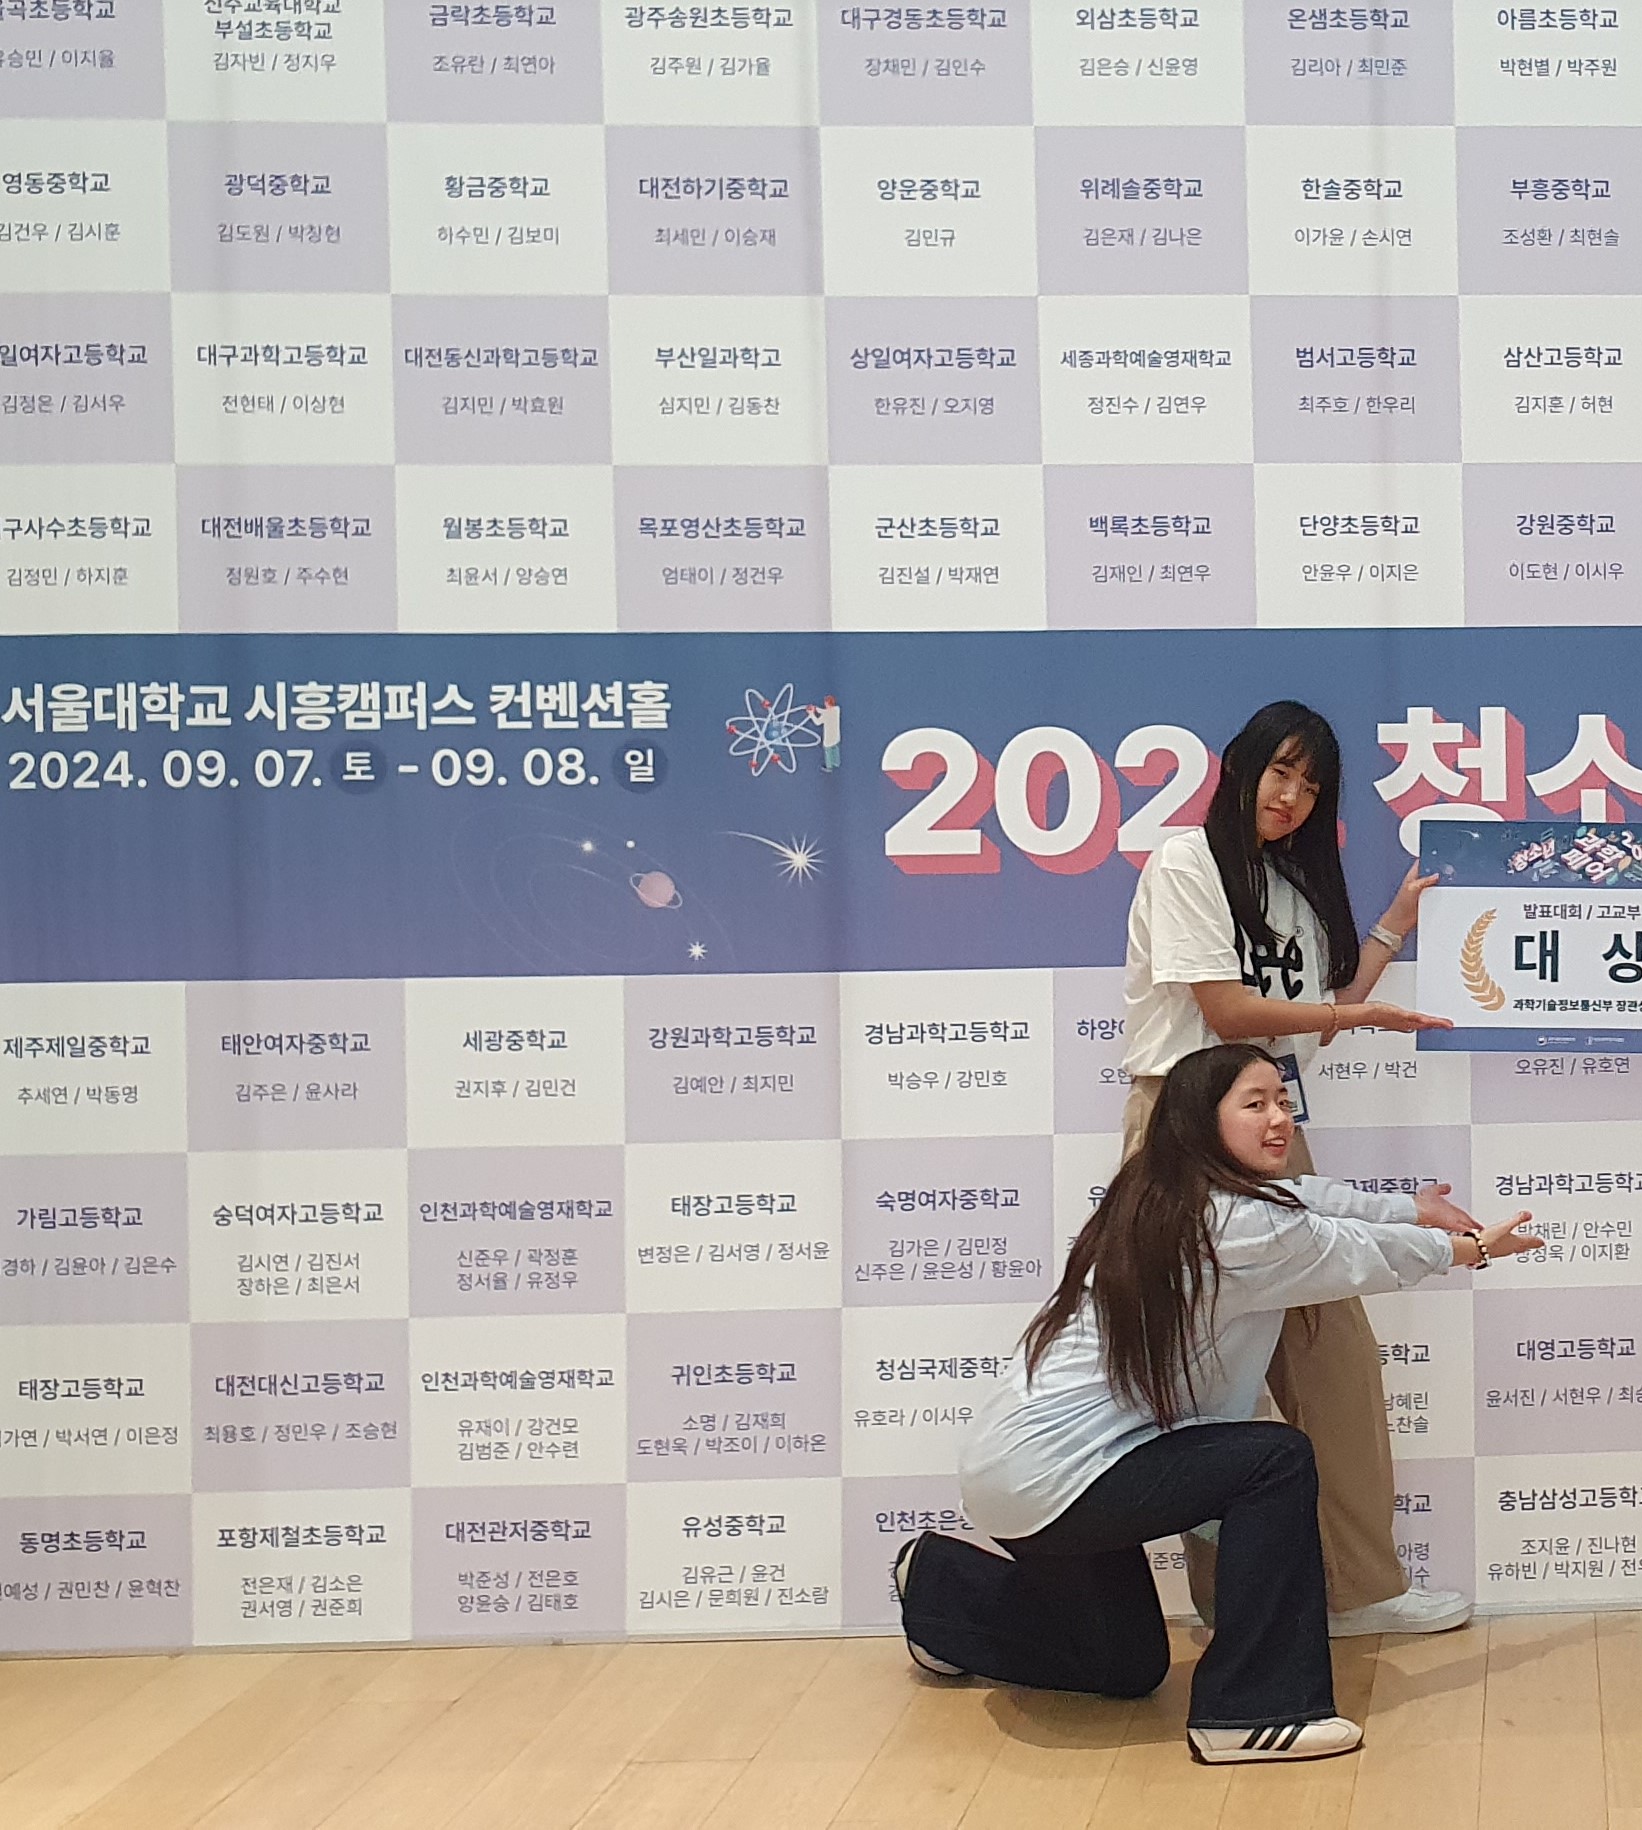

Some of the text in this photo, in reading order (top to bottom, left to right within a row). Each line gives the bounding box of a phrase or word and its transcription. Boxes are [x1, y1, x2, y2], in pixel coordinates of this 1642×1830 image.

[624, 5, 794, 30] 광주송원초등학교
[1075, 7, 1200, 31] 외삼초등학교
[1287, 7, 1411, 31] 온샘초등학교
[1496, 7, 1620, 31] 아름초등학교
[1499, 57, 1617, 78] 박현별 / 박주원
[1, 170, 112, 195] 영동중학교
[444, 174, 551, 200] 황금중학교
[638, 175, 790, 201] 대전하기중학교
[876, 178, 982, 202] 양운중학교
[1079, 177, 1204, 201] 위례솔중학교
[1300, 177, 1404, 201] 한솔중학교
[1509, 177, 1612, 201] 부흥중학교
[904, 228, 956, 248] 김민규
[1294, 227, 1412, 248] 이가윤 / 손시연
[196, 343, 369, 369] 대구과학고등학교
[654, 346, 783, 371] 부산일과학고
[849, 346, 1017, 370] 상일여자고등학교
[1295, 345, 1418, 370] 범서고등학교
[1503, 345, 1624, 369] 삼산고등학교
[874, 516, 1001, 540] 군산초등학교
[1088, 514, 1213, 539] 백록초등학교
[1299, 514, 1421, 538] 단양초등학교
[1516, 513, 1616, 537] 강원중학교
[0, 680, 672, 733] 서울대학교 시흥캠퍼스 컨벤션홀
[8, 750, 147, 790] 2024.
[162, 749, 240, 789] 09.
[254, 748, 322, 788] 07.
[342, 751, 376, 781] 토
[431, 748, 508, 787] 09.
[523, 747, 599, 787] 08.
[624, 748, 655, 783] 일
[881, 724, 1228, 868] 202
[1523, 903, 1642, 921] 발표대회 / 고교부
[1513, 929, 1560, 984] 대
[1512, 998, 1614, 1013] 과학기술정보통신부
[462, 1028, 569, 1053] 세광중학교
[864, 1019, 1031, 1046] 경남과학고등학교
[2, 1034, 152, 1060] 제주제일중학교
[1514, 1056, 1630, 1077] 오유진 / 유호연
[887, 1069, 1008, 1091] 박승우 / 강민호
[670, 1192, 798, 1218] 태장고등학교
[875, 1187, 1021, 1213] 숙명여자중학교
[16, 1205, 144, 1231] 가림고등학교
[1516, 1336, 1637, 1362] 대영고등학교
[214, 1371, 386, 1398] 대전대신고등학교
[670, 1361, 798, 1387] 귀인초등학교
[216, 1523, 388, 1550] 포항제철초등학교
[681, 1513, 787, 1539] 유성중학교
[18, 1528, 148, 1555] 동명초등학교
[1520, 1534, 1637, 1556] 조지윤 / 진나현
